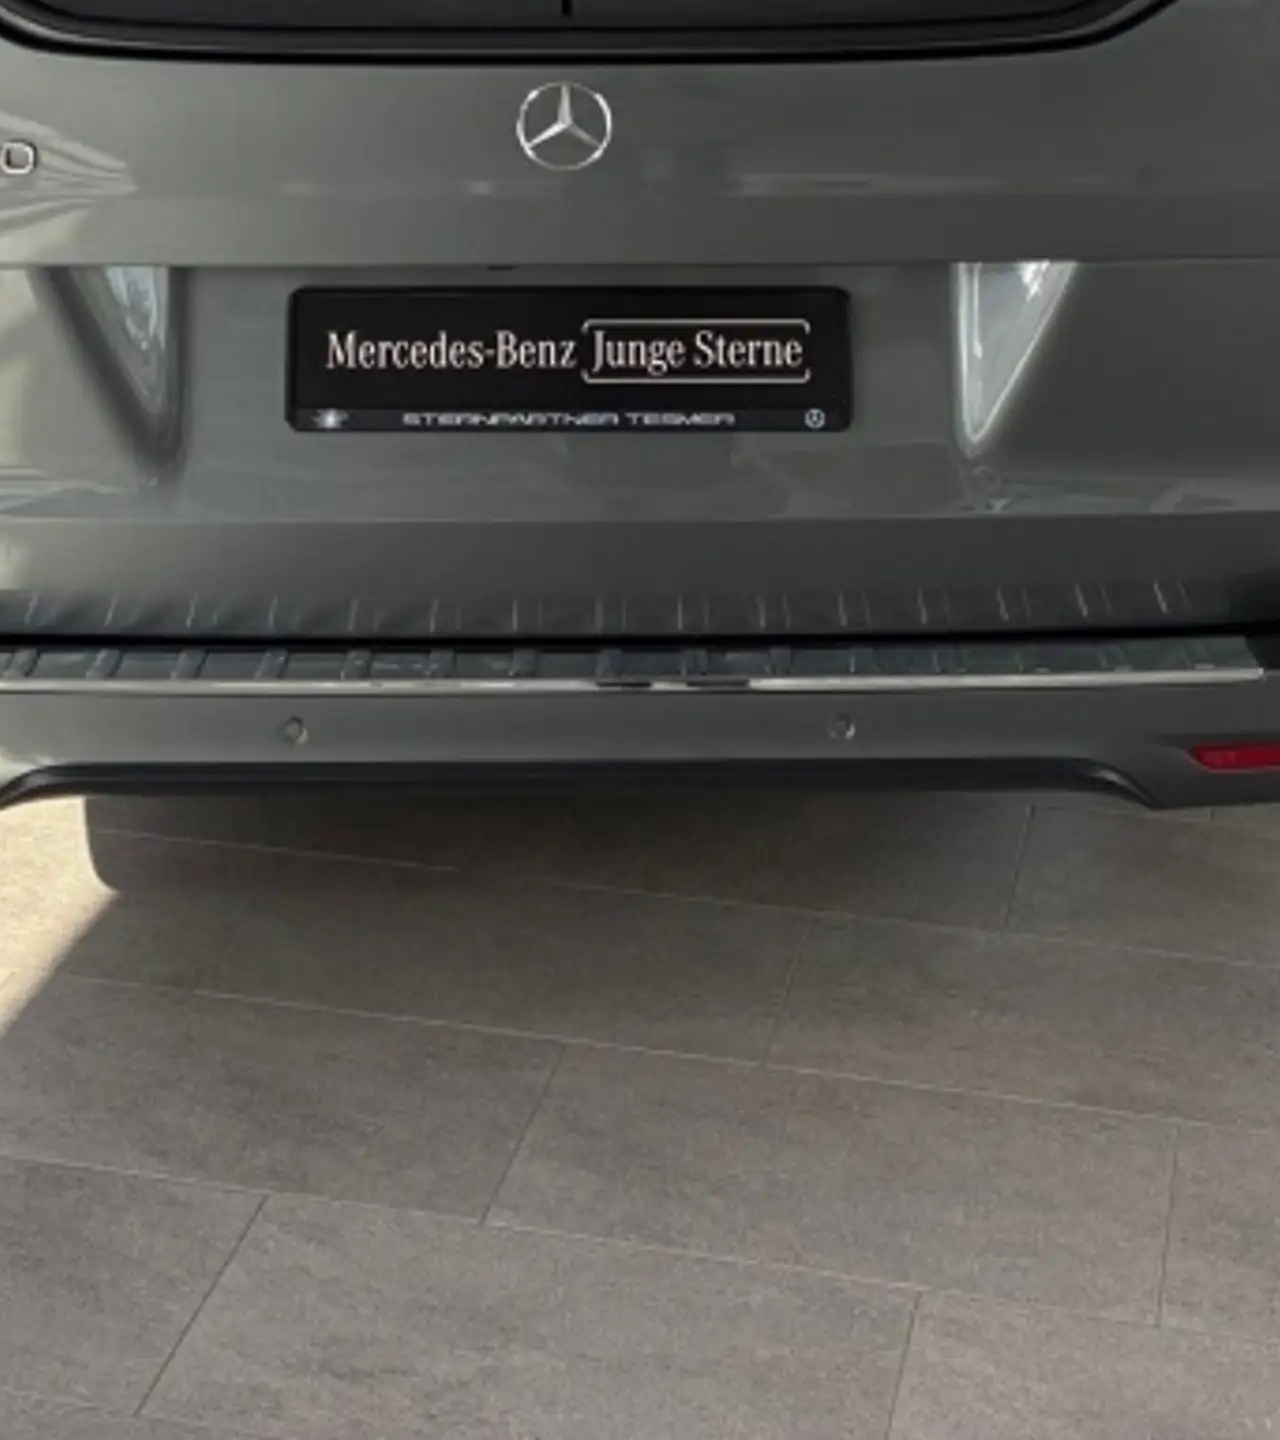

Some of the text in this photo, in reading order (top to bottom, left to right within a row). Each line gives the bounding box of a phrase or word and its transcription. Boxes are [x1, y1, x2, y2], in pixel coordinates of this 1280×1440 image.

[325, 329, 804, 376] Mercedes-Benz Junge Sterne
[402, 411, 620, 426] STERNPARTNER
